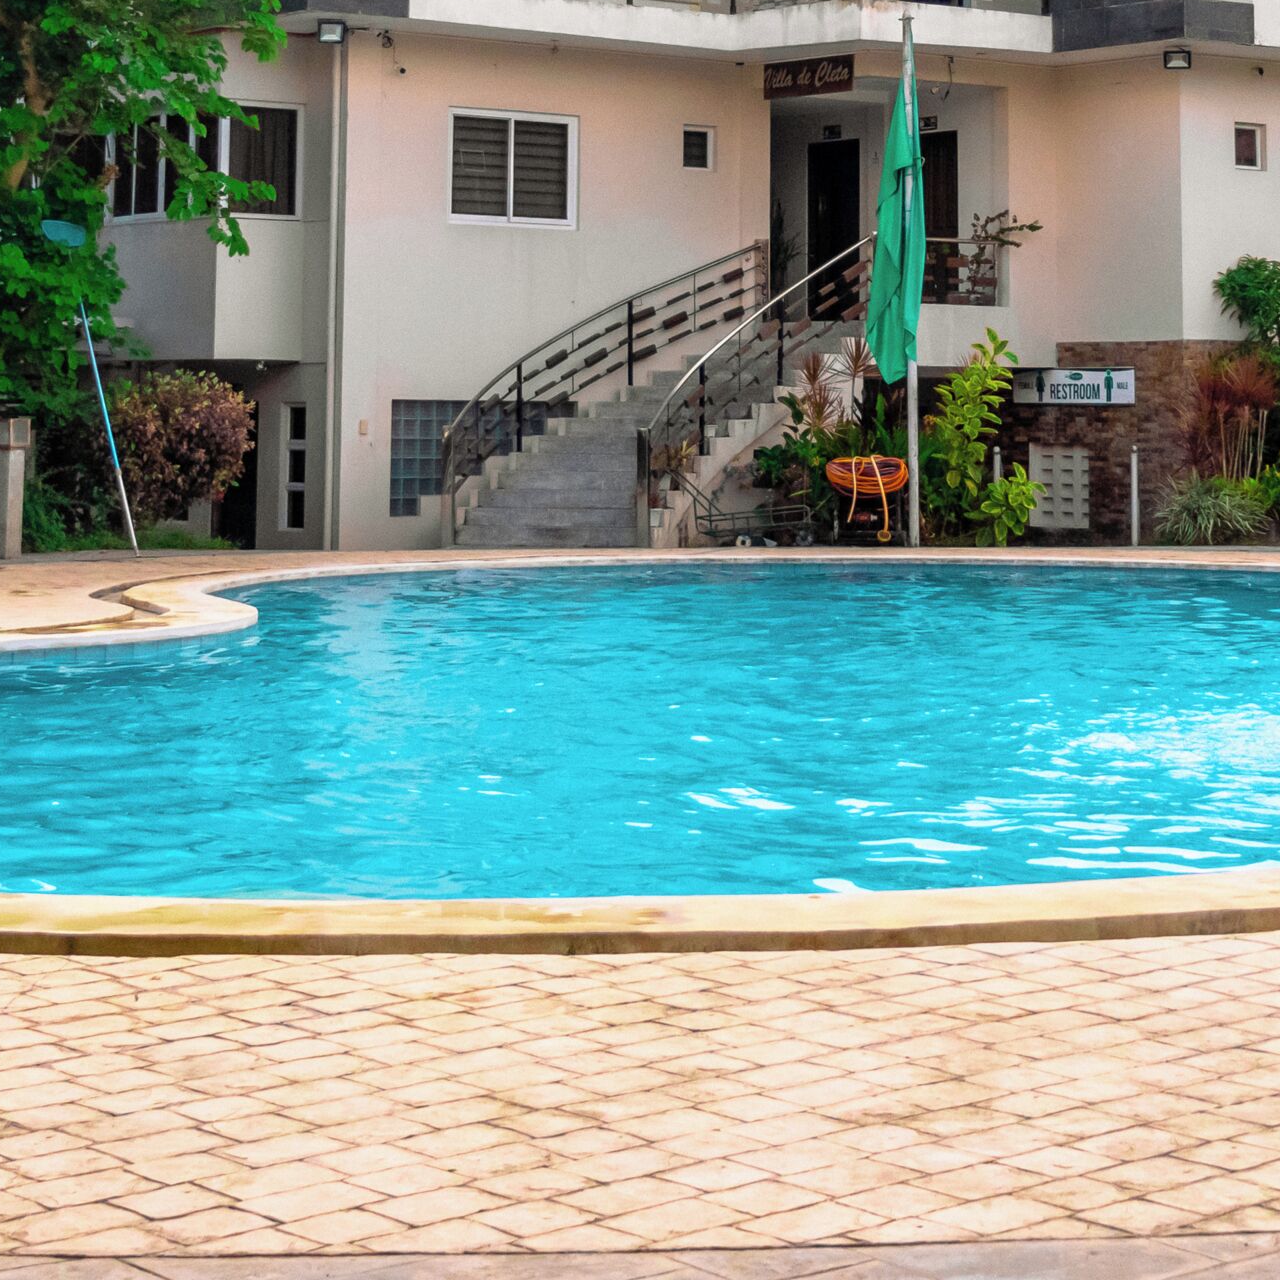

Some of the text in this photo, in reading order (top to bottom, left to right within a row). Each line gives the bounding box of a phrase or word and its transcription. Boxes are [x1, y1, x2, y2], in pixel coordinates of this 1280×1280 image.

[765, 61, 850, 88] Villa de Cleta
[1050, 383, 1101, 400] RESTROOM
